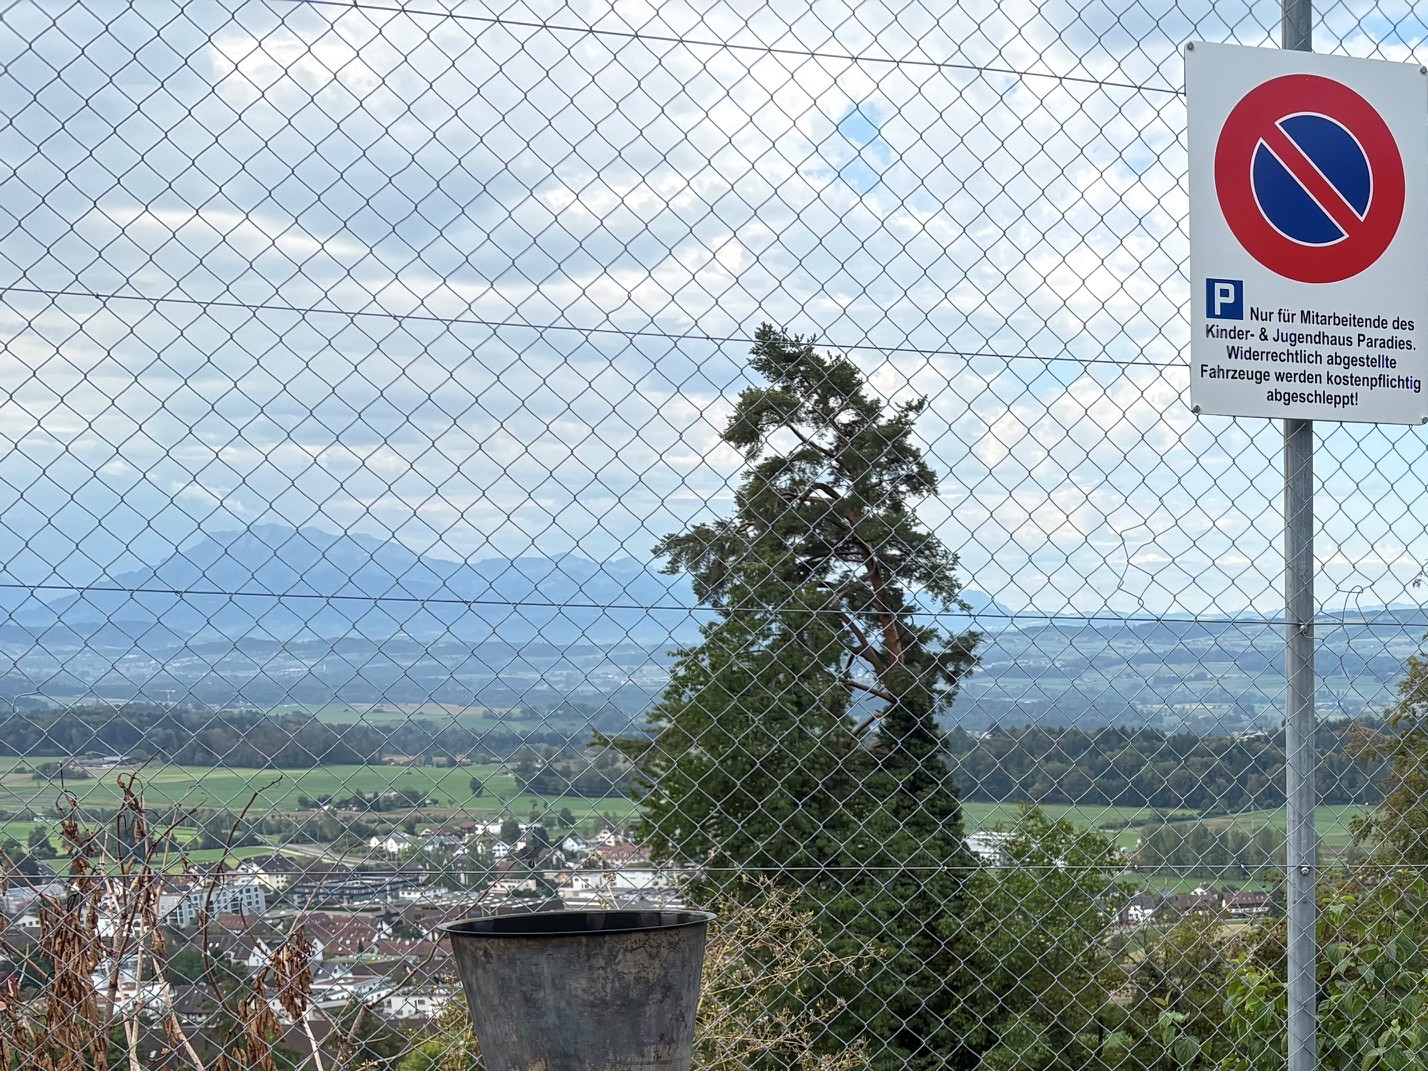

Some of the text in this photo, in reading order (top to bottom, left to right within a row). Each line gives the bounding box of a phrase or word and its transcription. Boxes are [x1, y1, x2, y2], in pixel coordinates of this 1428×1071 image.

[1215, 283, 1235, 316] P
[1250, 307, 1415, 331] Nur für Mitarbeitende des
[1205, 324, 1416, 351] Kinder- & Jugendhaus Paradies.
[1226, 345, 1397, 370] Widerrechtlich abgestellte
[1200, 364, 1422, 393] Fahrzeuge werden kostenpflichtig
[1266, 389, 1359, 408] abgeschleppt!
